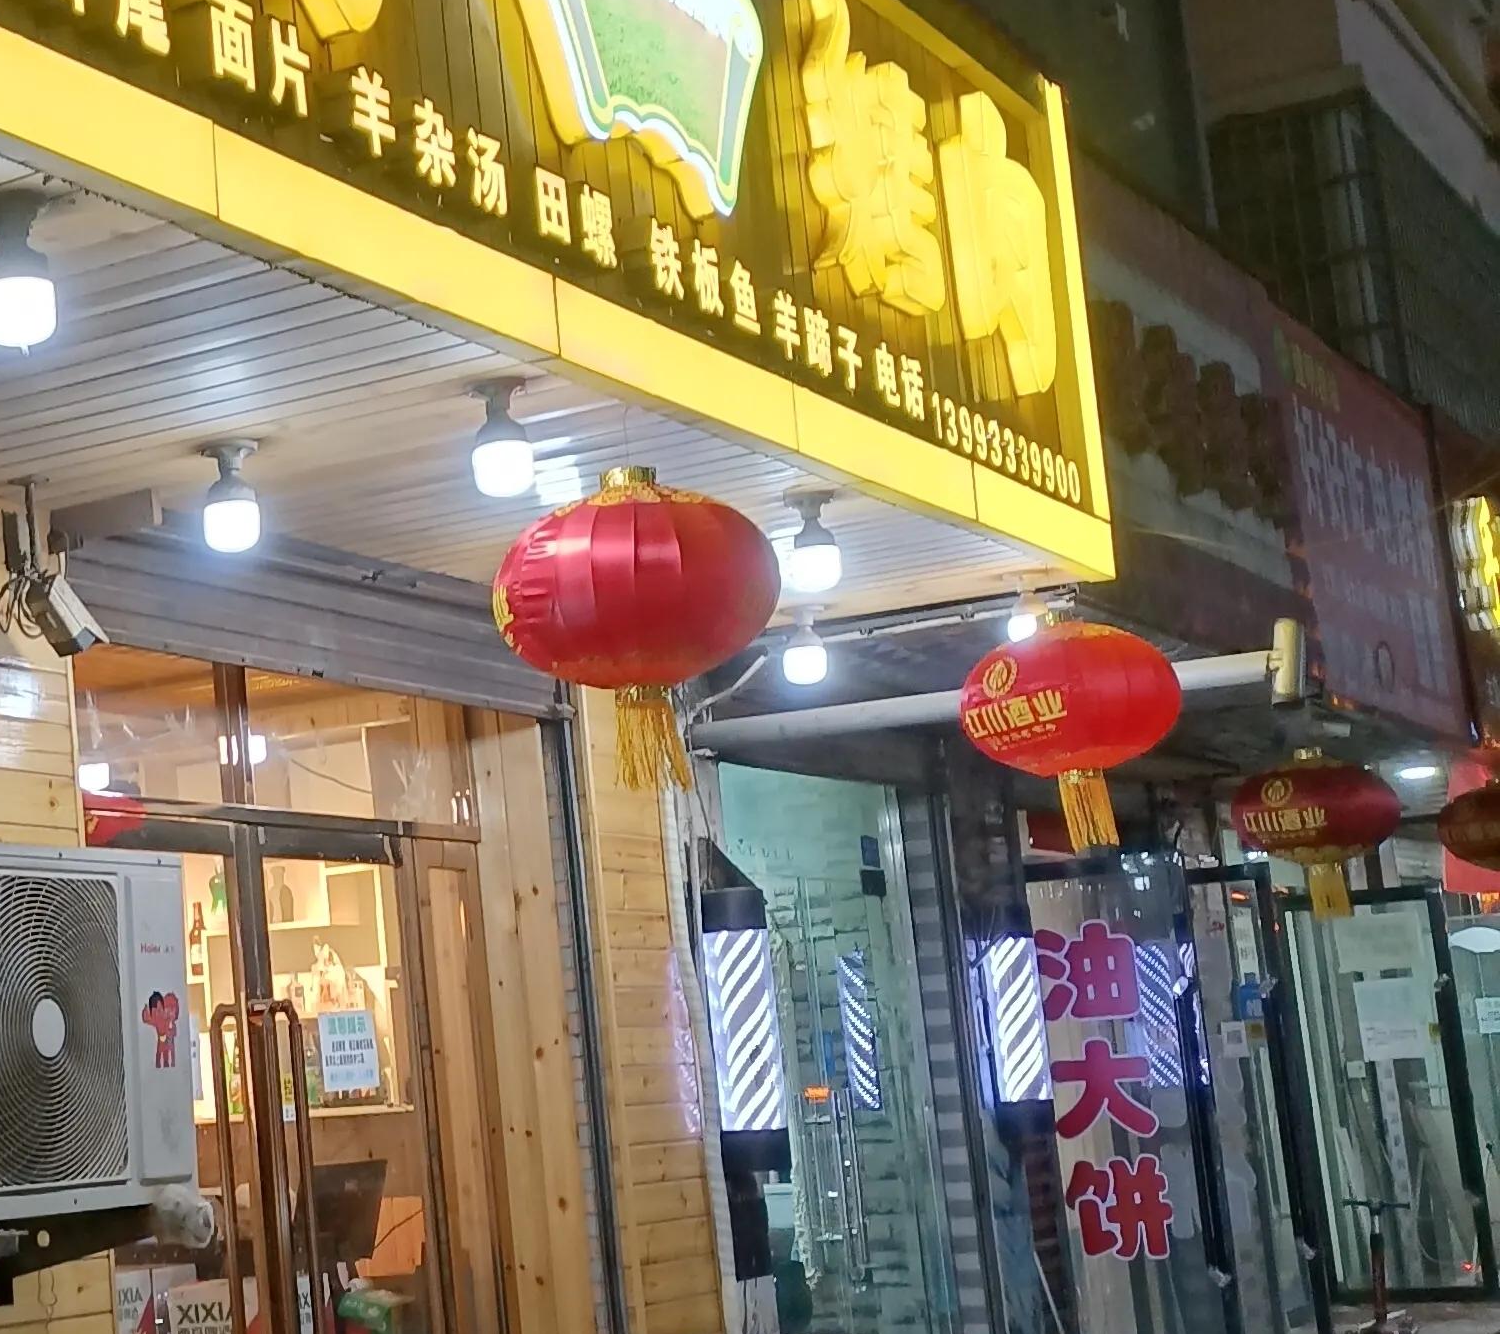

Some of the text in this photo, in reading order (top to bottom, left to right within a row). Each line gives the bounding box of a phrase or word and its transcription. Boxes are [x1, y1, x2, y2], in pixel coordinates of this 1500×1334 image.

[351, 65, 508, 218] 羊杂汤
[535, 166, 618, 268] 田螺
[650, 217, 762, 336] 铁板鱼
[773, 289, 863, 394] 羊蹄子
[874, 341, 925, 422] 电话
[931, 391, 1081, 504] 13993339900
[1033, 919, 1173, 1261] 油大饼
